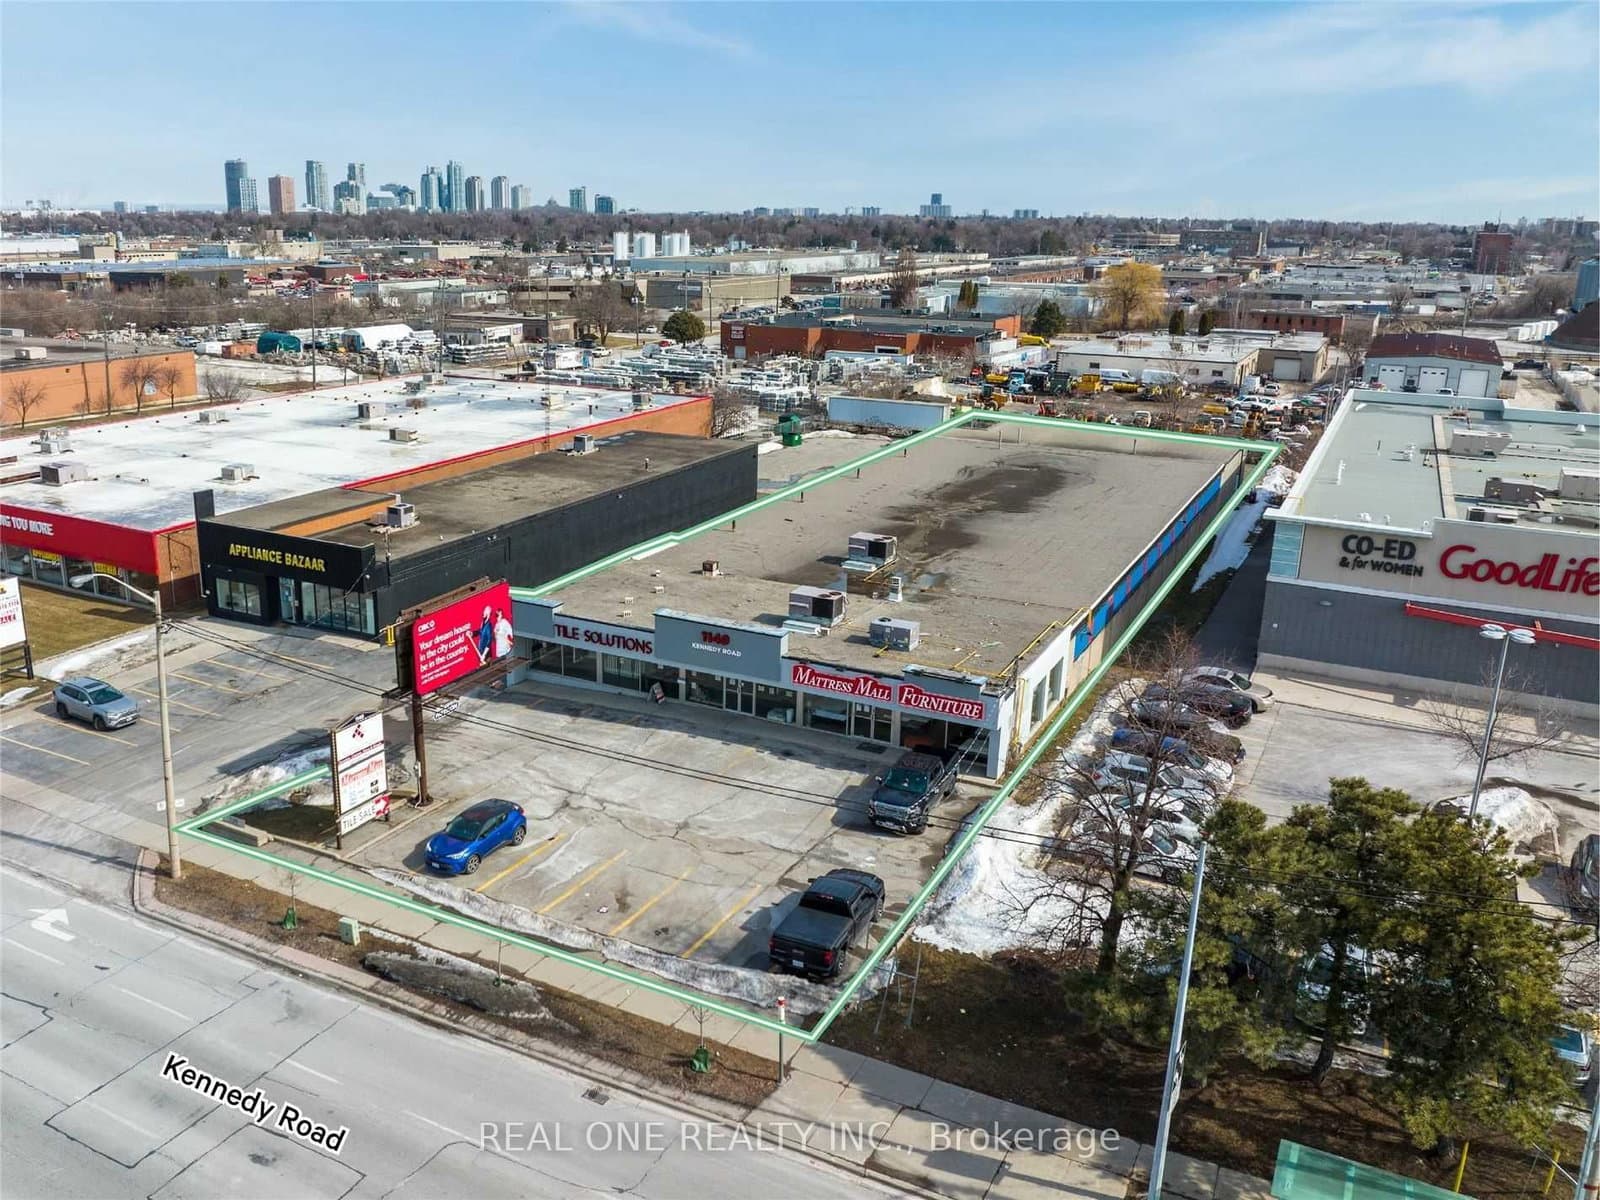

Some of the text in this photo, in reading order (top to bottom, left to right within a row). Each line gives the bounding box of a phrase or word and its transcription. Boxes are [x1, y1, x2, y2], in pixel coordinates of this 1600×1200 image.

[11, 517, 28, 531] YOU
[29, 520, 54, 535] MORE
[229, 543, 326, 572] APPLIANCE BAZAAR
[1341, 534, 1417, 561] CO-ED
[1339, 556, 1424, 577] & for WOMEN
[1439, 544, 1600, 596] GoodLife
[419, 622, 471, 651] Your dream house
[426, 648, 437, 659] the
[436, 643, 449, 654] city
[448, 633, 465, 647] could
[554, 623, 653, 655] TILE SOLUTIONS
[692, 642, 742, 658] KENNEDY ROAD
[435, 655, 447, 665] the
[794, 666, 891, 701] MATTRESS MALL
[901, 687, 982, 718] FURNITURE
